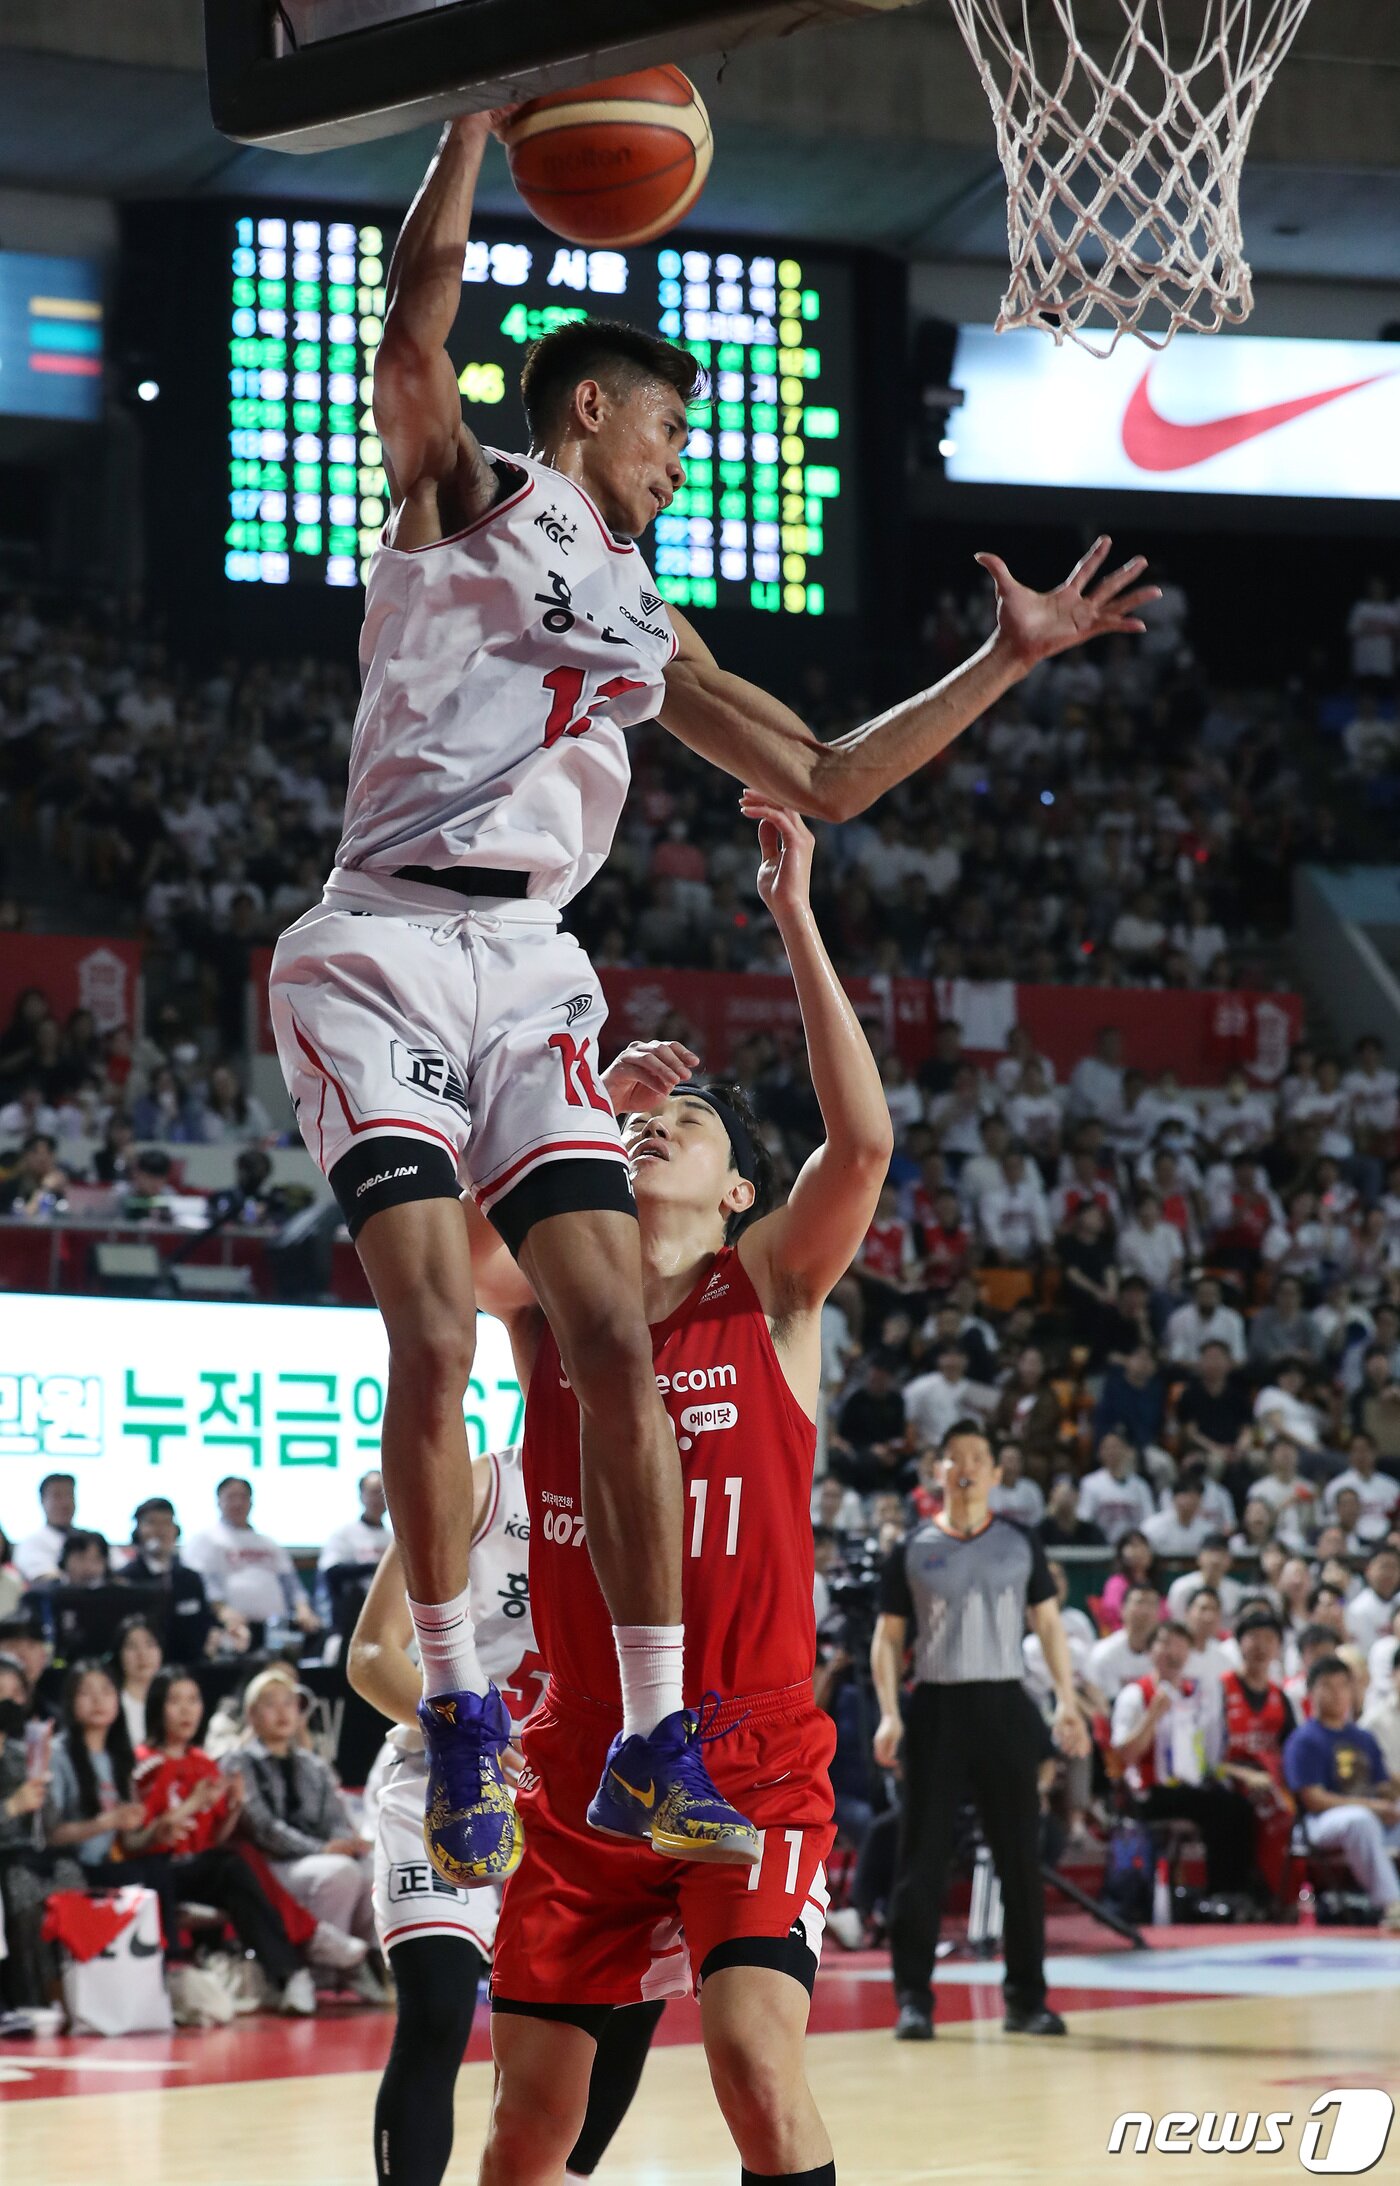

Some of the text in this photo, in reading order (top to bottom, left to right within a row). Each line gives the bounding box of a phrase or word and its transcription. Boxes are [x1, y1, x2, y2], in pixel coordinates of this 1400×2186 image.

[534, 511, 575, 556] KGC
[619, 605, 669, 643] CORALIAN
[356, 1165, 418, 1197] CORALIAN
[656, 1364, 737, 1395] ecom
[689, 1407, 732, 1427] 에이닷
[504, 1521, 530, 1540] KG
[543, 1509, 587, 1547] 007
[690, 1477, 743, 1558] 11
[748, 1830, 803, 1895] 11
